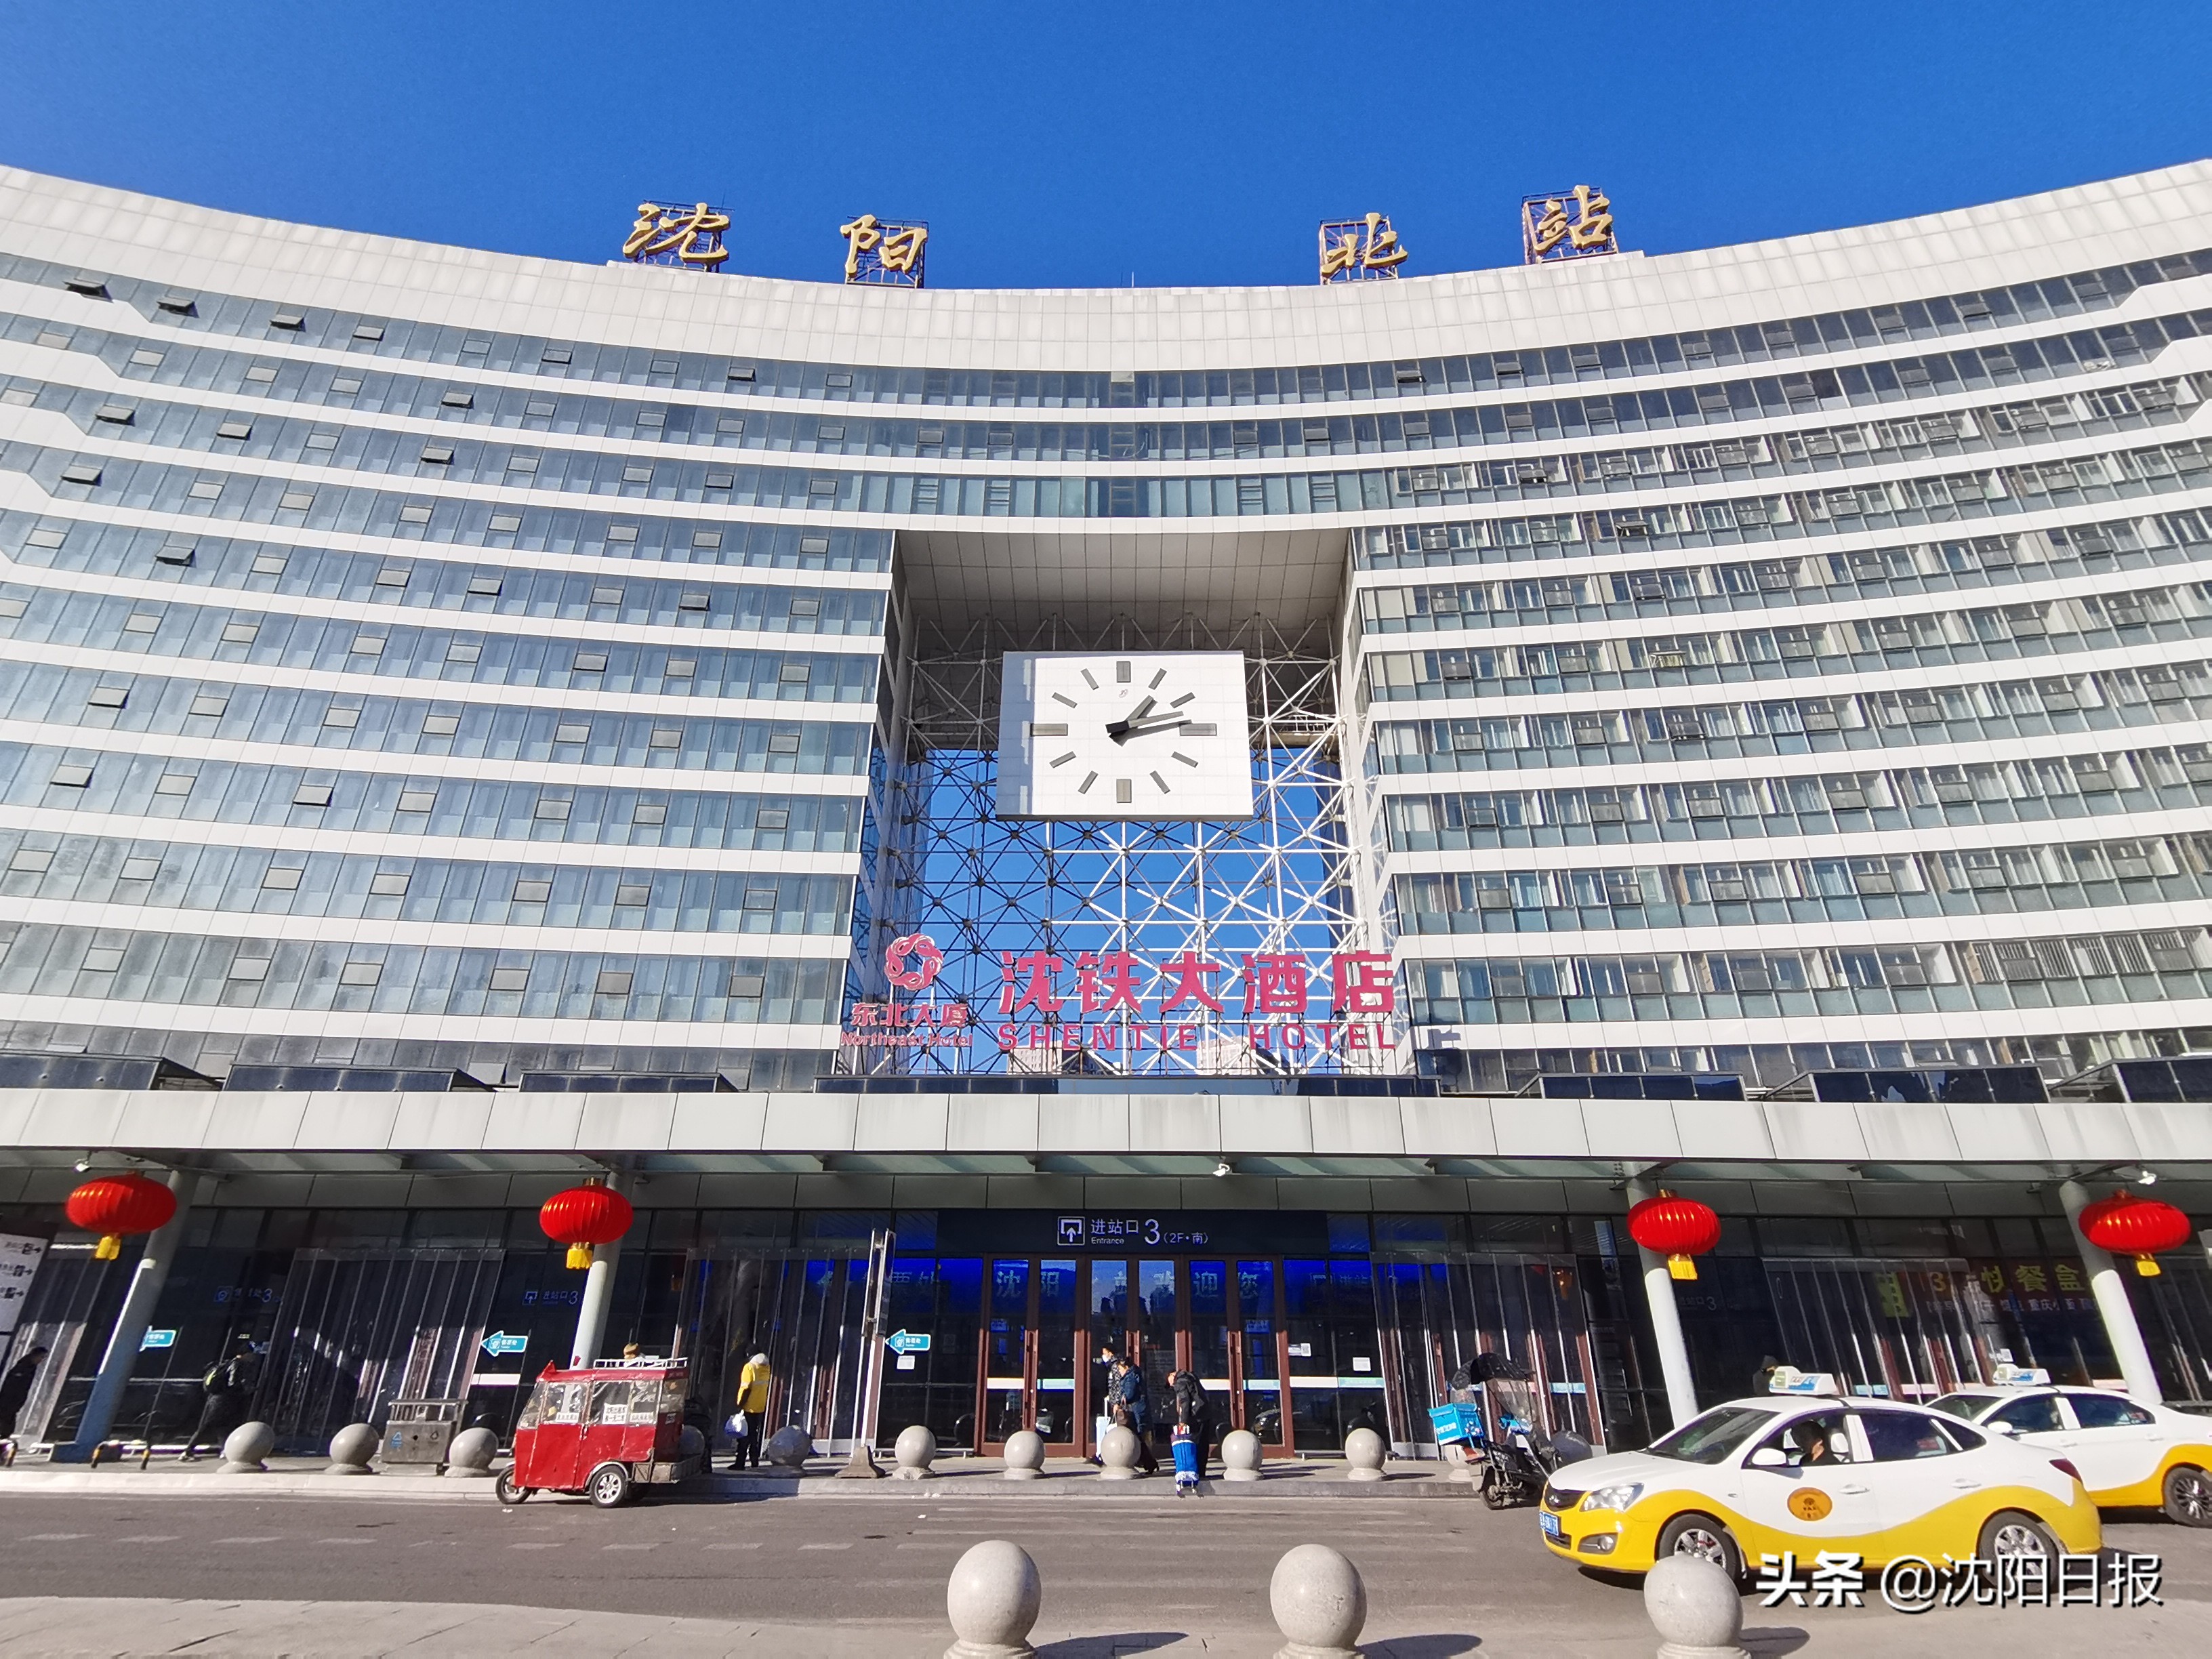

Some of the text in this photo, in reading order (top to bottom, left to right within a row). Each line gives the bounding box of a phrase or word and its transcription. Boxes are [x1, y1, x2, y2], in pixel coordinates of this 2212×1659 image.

[623, 185, 1614, 279] 沈阳北站
[998, 951, 1394, 1015] 沈铁大酒店
[851, 1002, 968, 1027] 东北大厦
[840, 1031, 973, 1046] Northeast Hotel
[997, 1023, 1396, 1051] SHENTIE HOTEL
[1090, 1218, 1139, 1235] 进站口
[1144, 1218, 1160, 1244] 3
